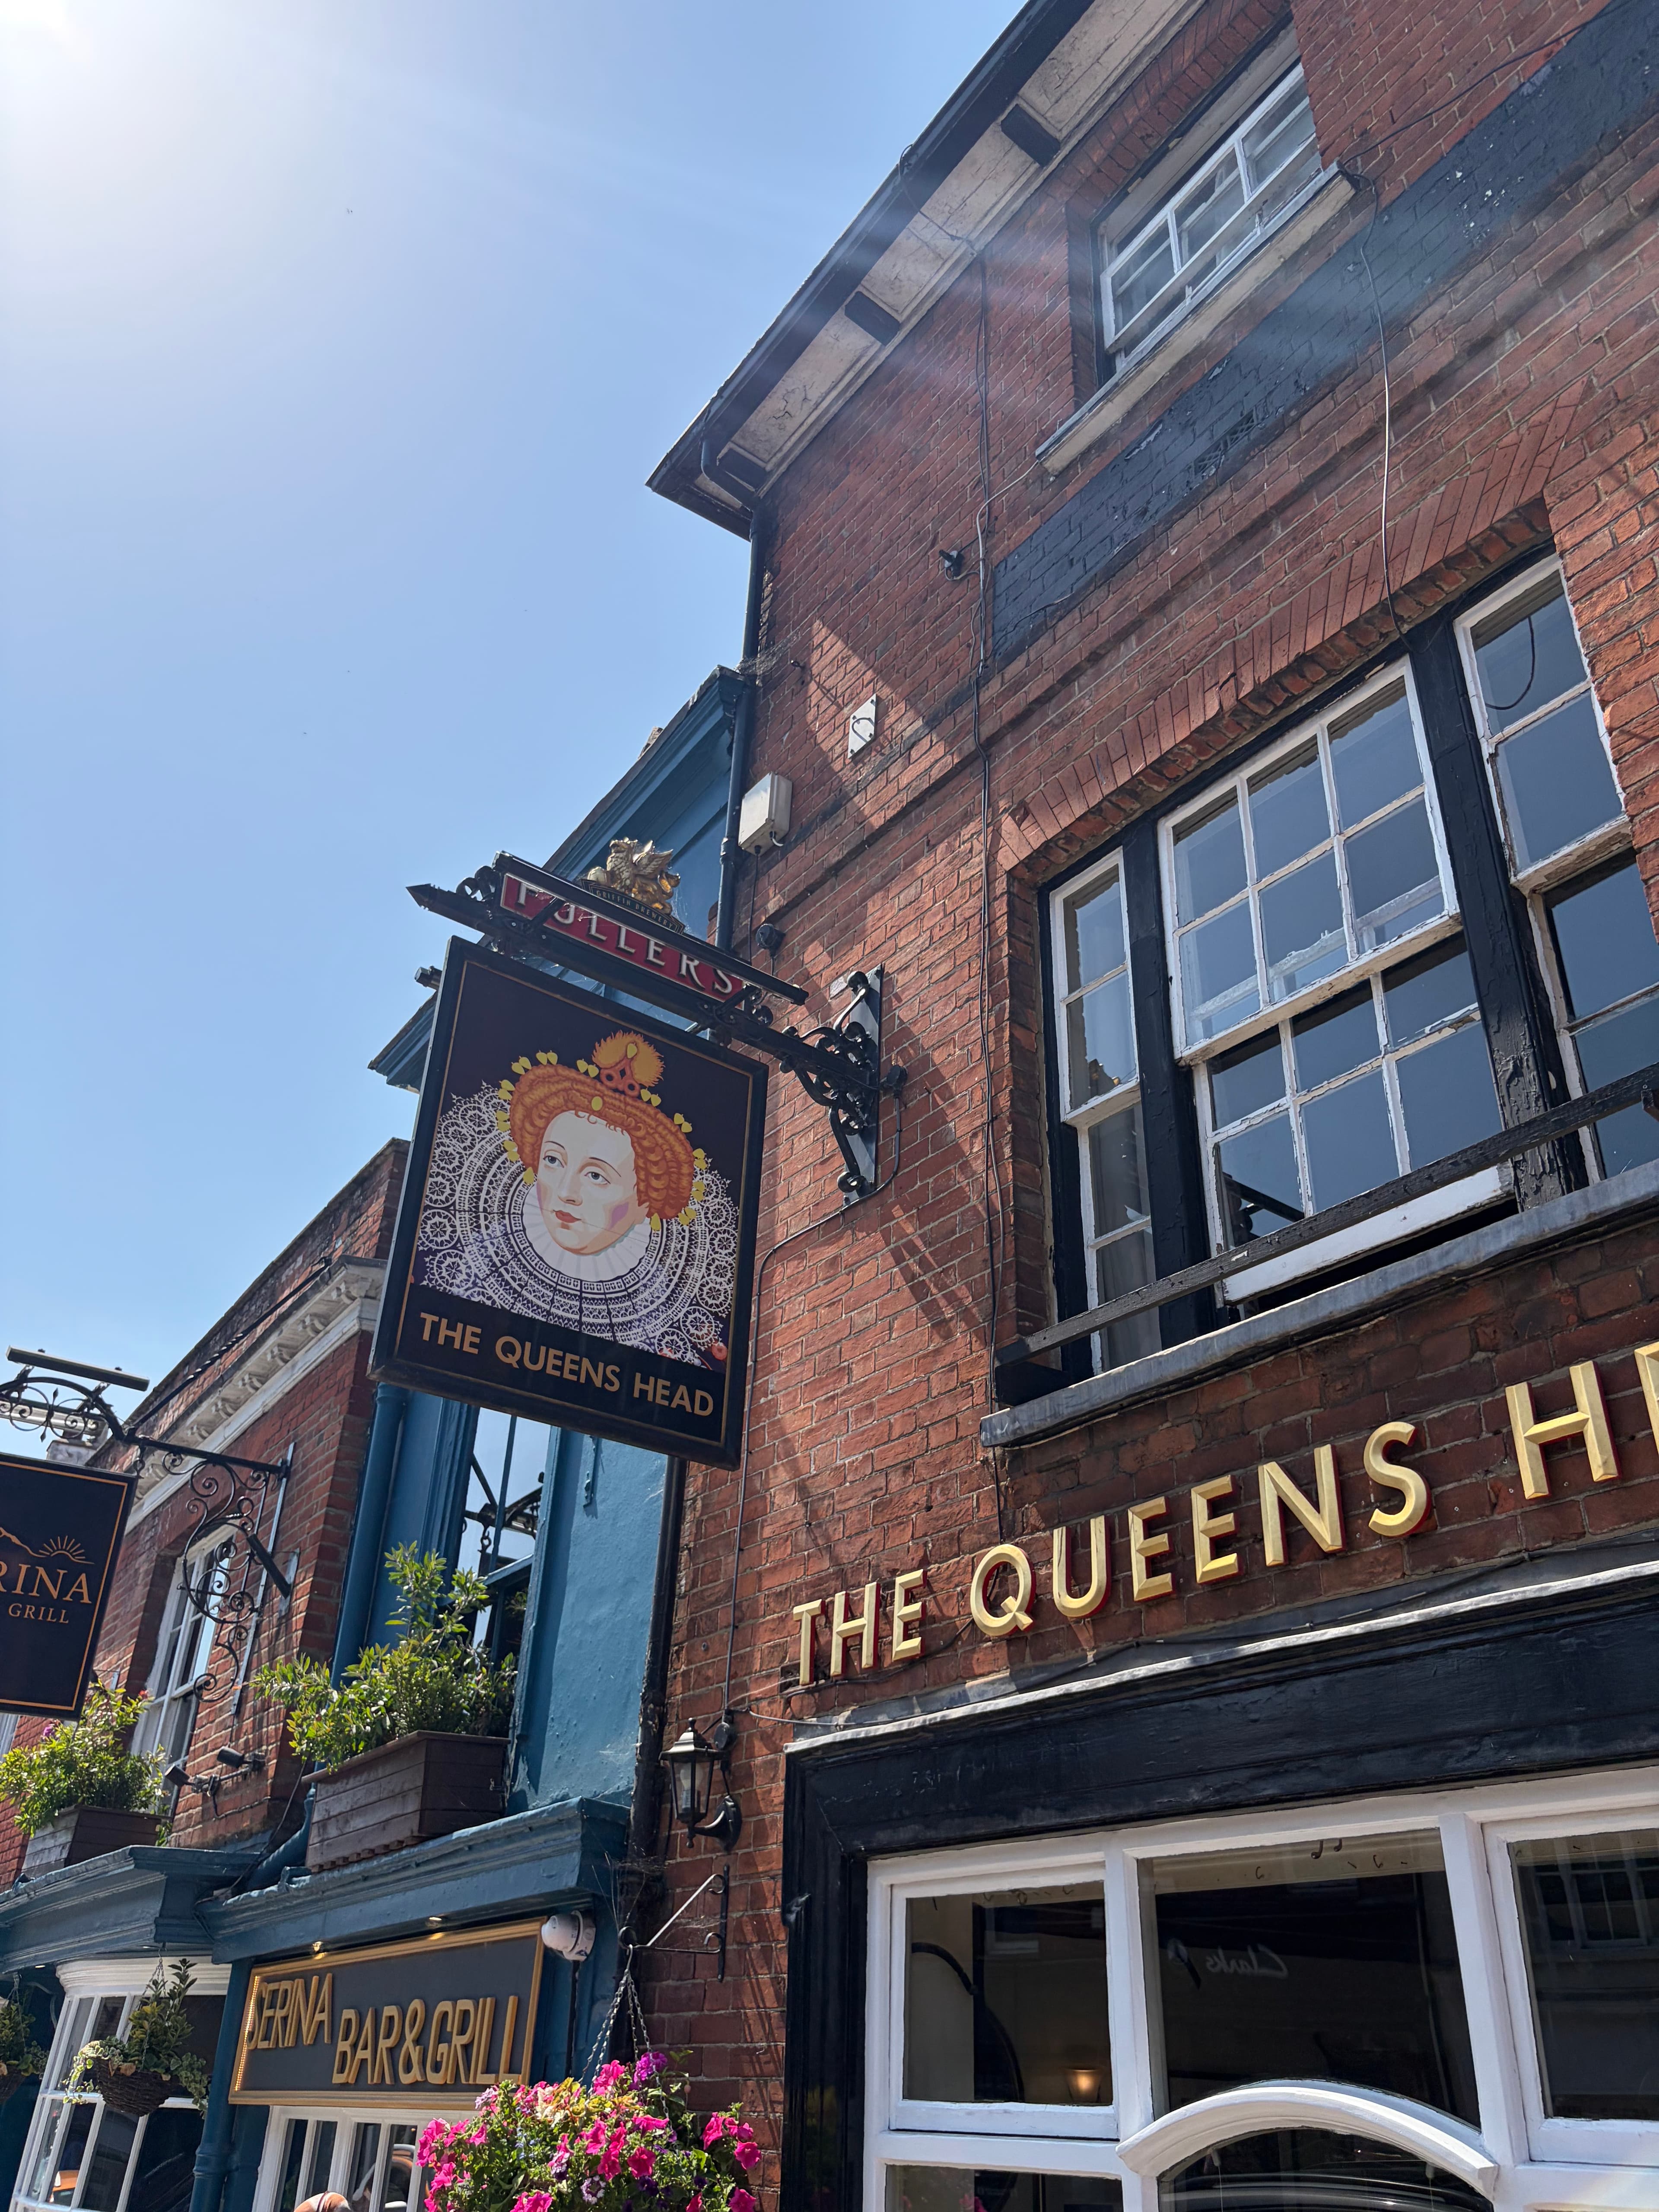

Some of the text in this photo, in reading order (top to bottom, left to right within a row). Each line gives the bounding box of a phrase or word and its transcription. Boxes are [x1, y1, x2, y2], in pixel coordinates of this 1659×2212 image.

[596, 890, 673, 929] GRIFFIN BREWERY
[420, 1312, 714, 1417] THE QUEENS HEAD
[793, 1568, 928, 1686] THE
[969, 1421, 1432, 1637] QUEENS
[8, 1603, 69, 1624] GRILL
[247, 1973, 332, 2050] SERINA
